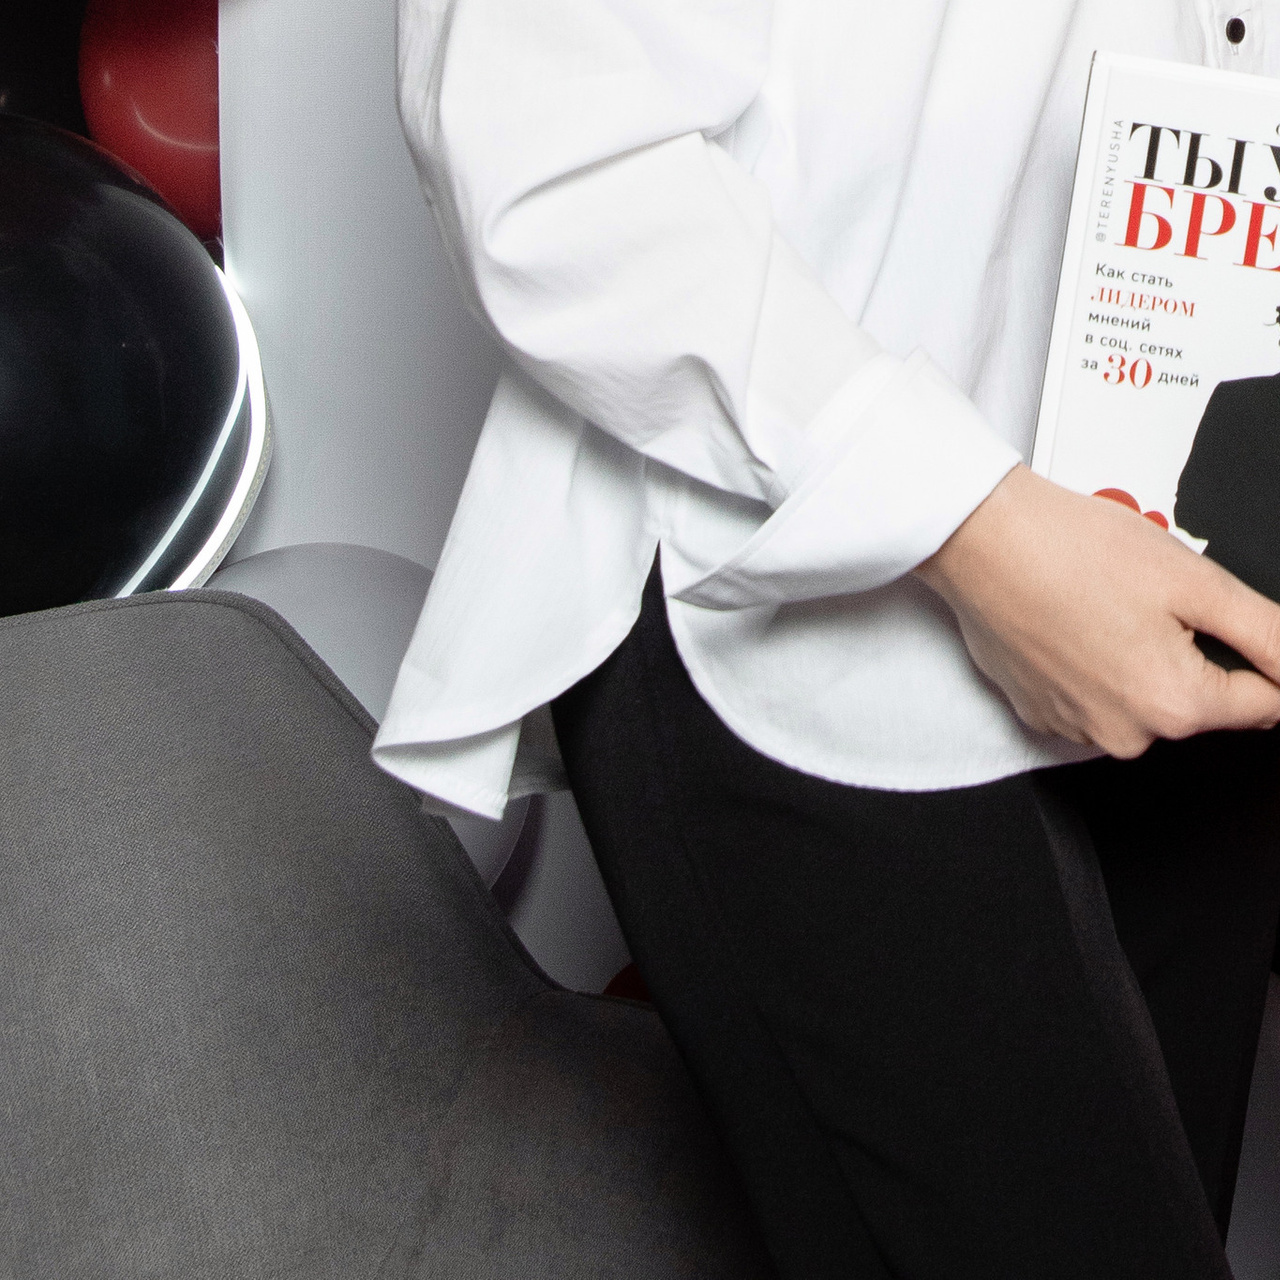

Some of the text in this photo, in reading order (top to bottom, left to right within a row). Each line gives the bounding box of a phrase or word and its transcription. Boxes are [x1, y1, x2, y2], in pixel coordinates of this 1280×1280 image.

[1095, 119, 1125, 243] @TERENYUSHA
[1095, 262, 1174, 288] Как стать
[1090, 286, 1196, 318] ЛИДЕРОМ
[1087, 312, 1151, 332] мнений
[1085, 333, 1184, 359] в соц. сетях
[1081, 352, 1200, 390] за 30 дней
